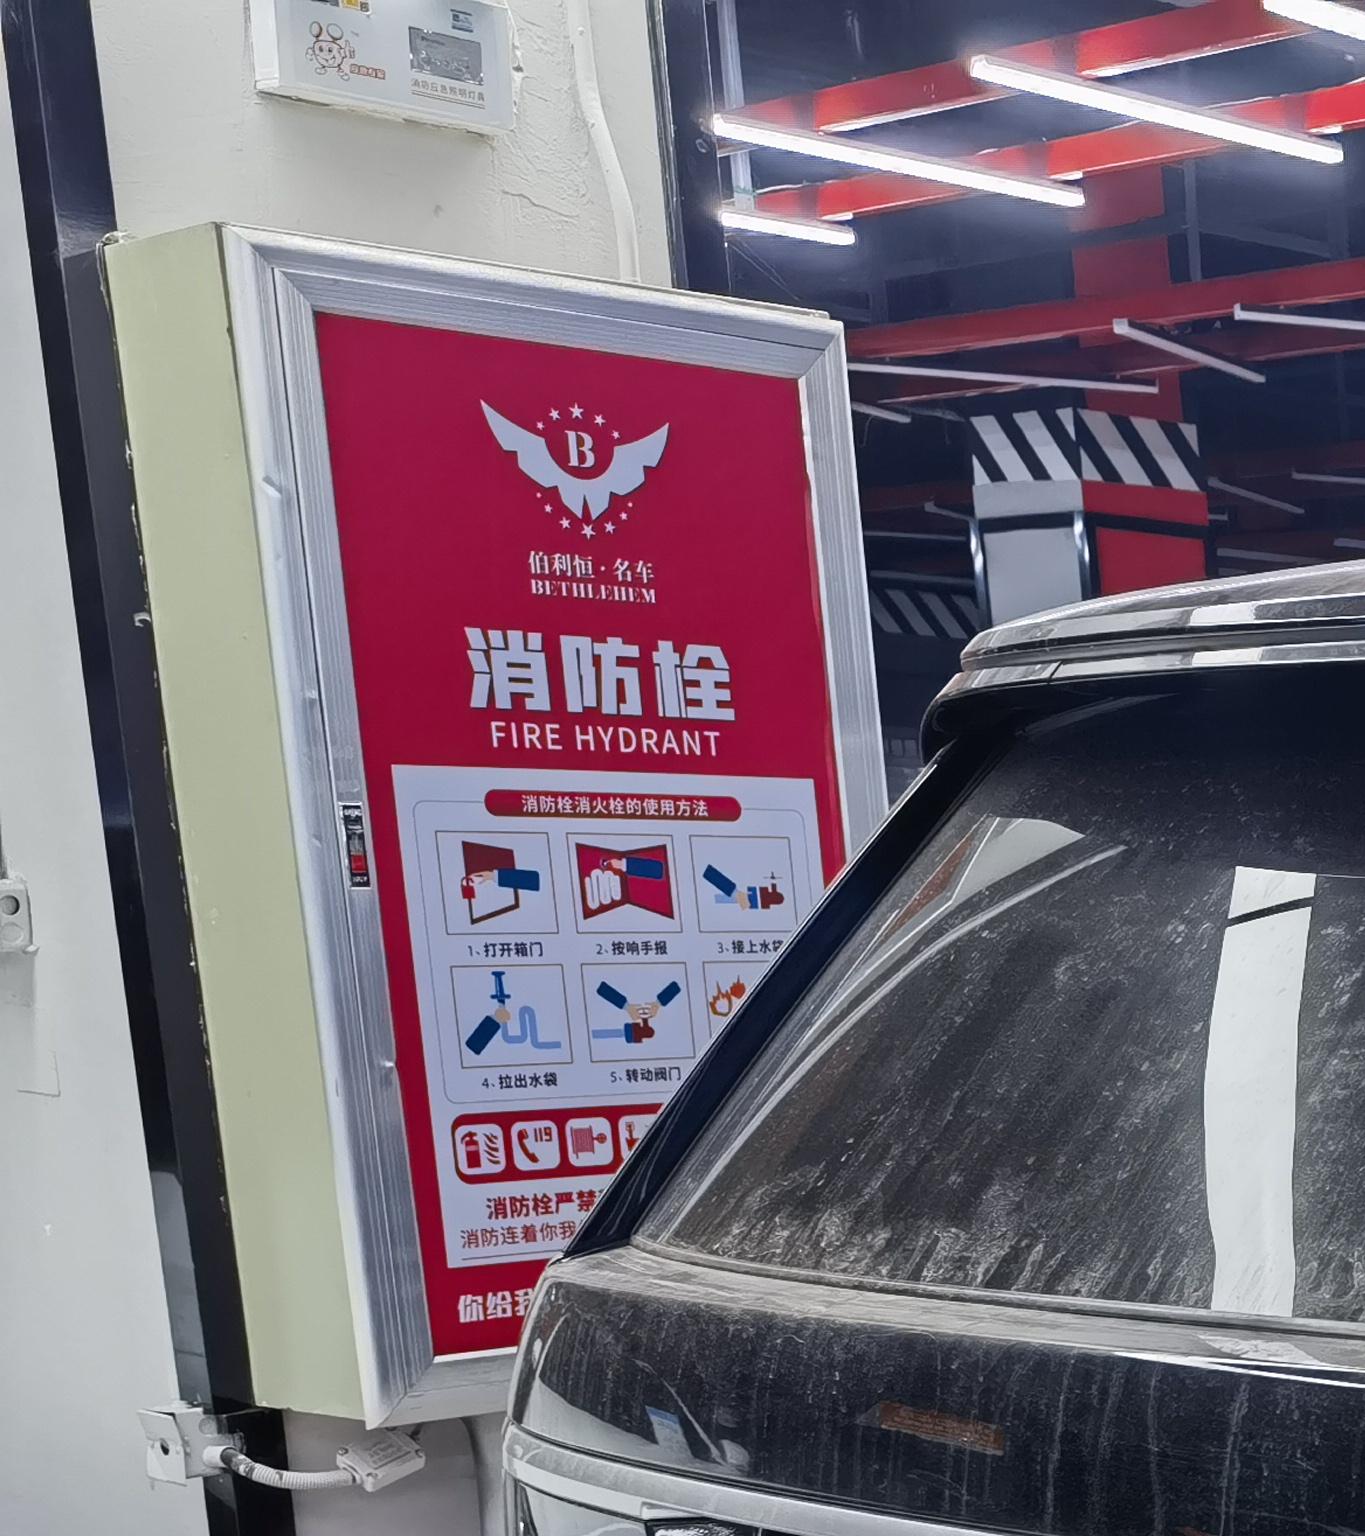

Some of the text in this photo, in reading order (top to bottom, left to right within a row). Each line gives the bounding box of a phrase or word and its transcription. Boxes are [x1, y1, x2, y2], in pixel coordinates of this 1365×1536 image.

[565, 430, 595, 468] B
[528, 550, 655, 584] 伯利恒·名车
[530, 579, 656, 604] BETHLEHEM
[464, 626, 736, 721] 消防栓
[490, 721, 720, 757] FIRE HYDRANT
[521, 794, 709, 818] 消防栓消火栓的使用方法
[467, 941, 544, 957] 1、打开箱门
[596, 940, 669, 957] 2、按响手报
[481, 1072, 558, 1090] 4、拉出水袋
[534, 1127, 553, 1143] 119
[486, 1189, 605, 1221] 消防栓严禁
[461, 1218, 584, 1248] 消防连着你我
